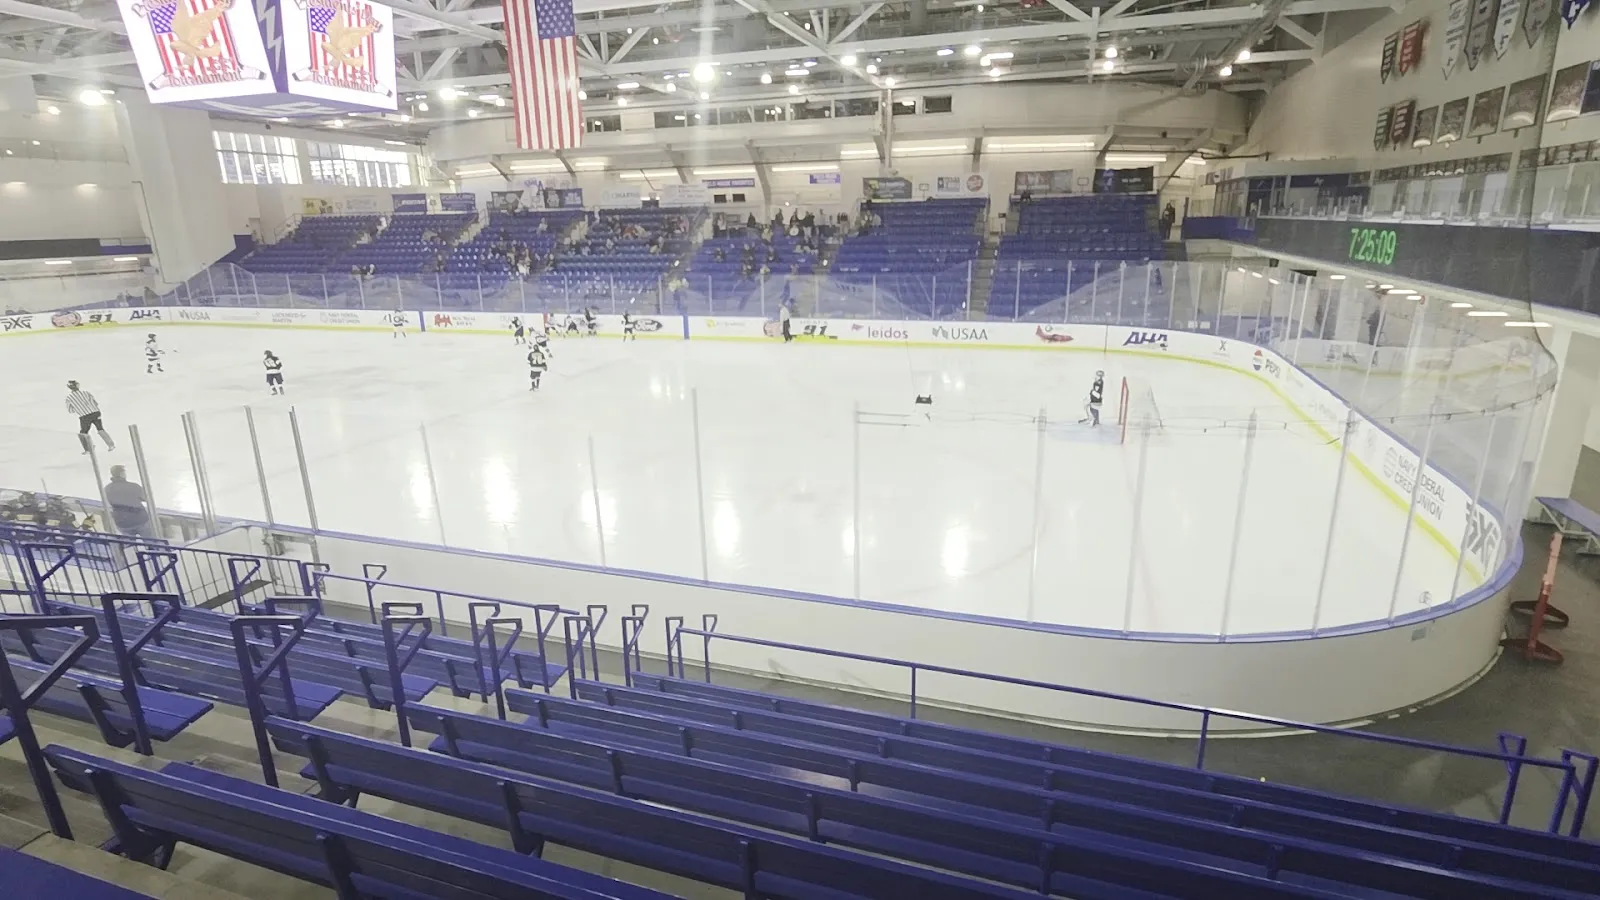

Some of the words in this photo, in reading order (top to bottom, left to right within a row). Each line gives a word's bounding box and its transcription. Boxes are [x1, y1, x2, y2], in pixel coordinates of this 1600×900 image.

[168, 70, 242, 87] Tournament
[311, 70, 376, 93] Tournament
[1349, 228, 1396, 265] 7:25:09
[0, 315, 33, 331] PXG
[189, 312, 211, 320] USAA
[803, 325, 827, 338] 91
[868, 326, 908, 338] leidos
[951, 328, 988, 340] USAA
[1394, 472, 1414, 495] CRED
[1419, 473, 1445, 502] DERAL
